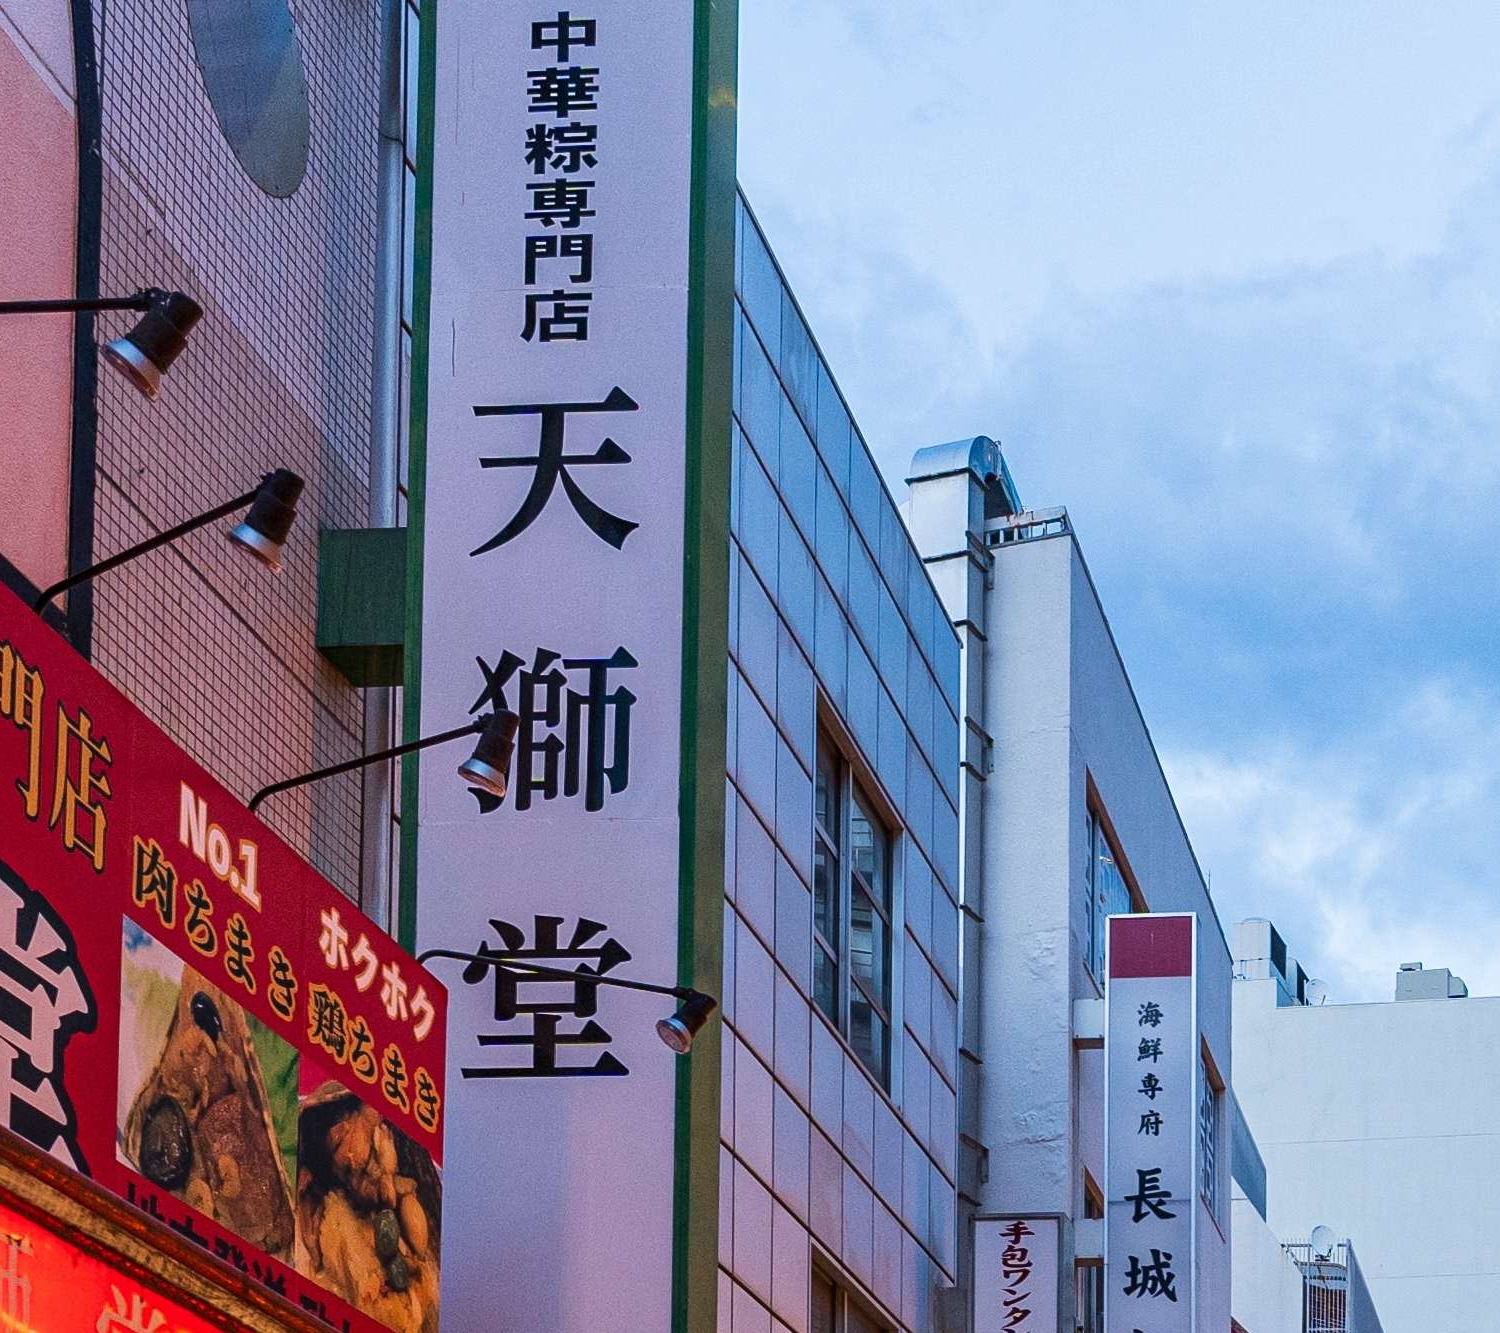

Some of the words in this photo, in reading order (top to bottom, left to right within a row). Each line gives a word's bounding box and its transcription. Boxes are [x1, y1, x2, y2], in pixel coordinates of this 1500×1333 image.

[519, 11, 600, 343] 中華粽専門店
[461, 385, 640, 1079] 天獅堂
[131, 834, 296, 1015] 肉ちまき
[178, 781, 262, 912] No.1
[318, 906, 436, 1040] ホクホク
[308, 982, 442, 1134] 鶏ちまき
